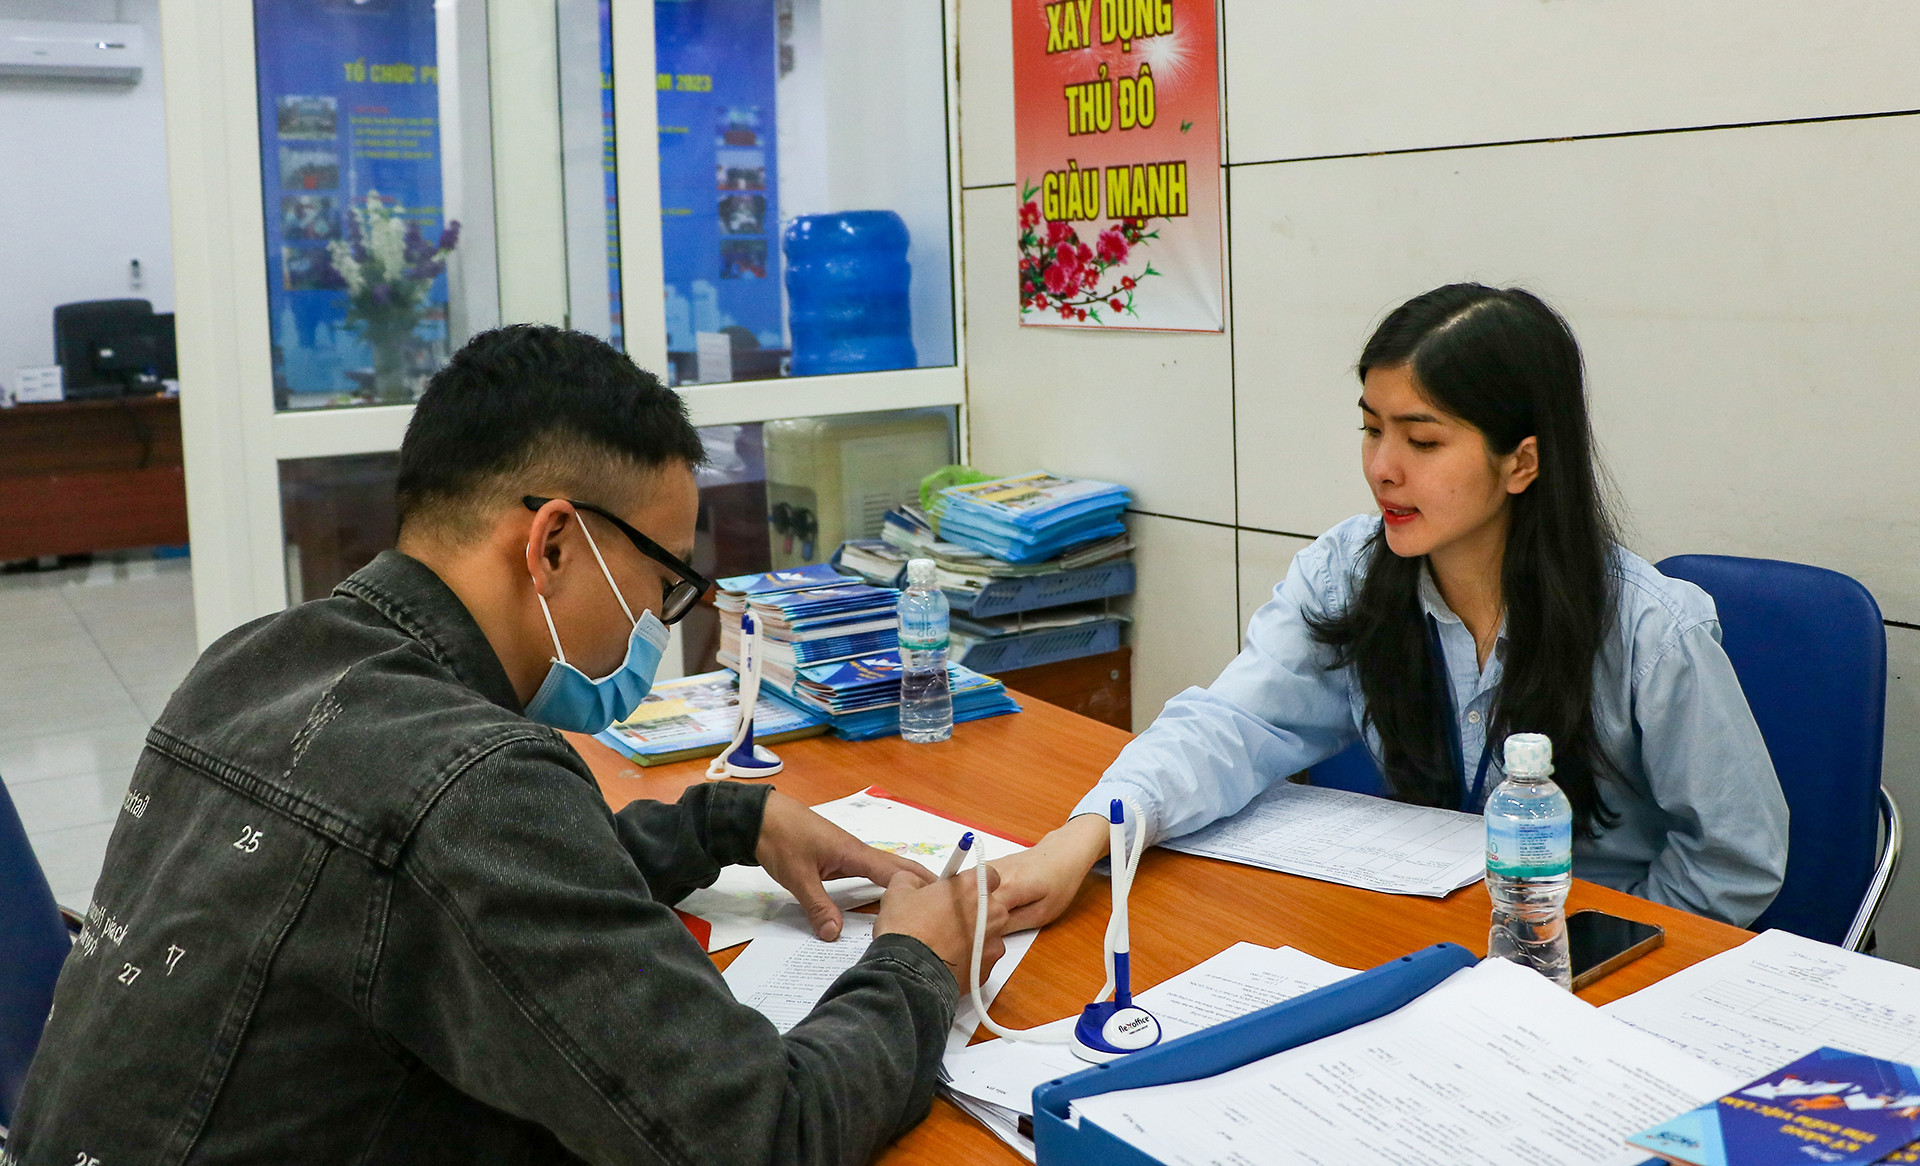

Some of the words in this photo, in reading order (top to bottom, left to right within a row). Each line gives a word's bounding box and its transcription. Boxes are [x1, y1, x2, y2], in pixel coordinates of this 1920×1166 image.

[676, 75, 712, 92] 2023
[1065, 63, 1112, 136] THỦ
[1118, 63, 1156, 131] ĐÔ
[1042, 159, 1100, 222] GIÀU
[1105, 160, 1189, 229] MẠNH
[233, 825, 263, 853] 25
[118, 962, 142, 987] 27
